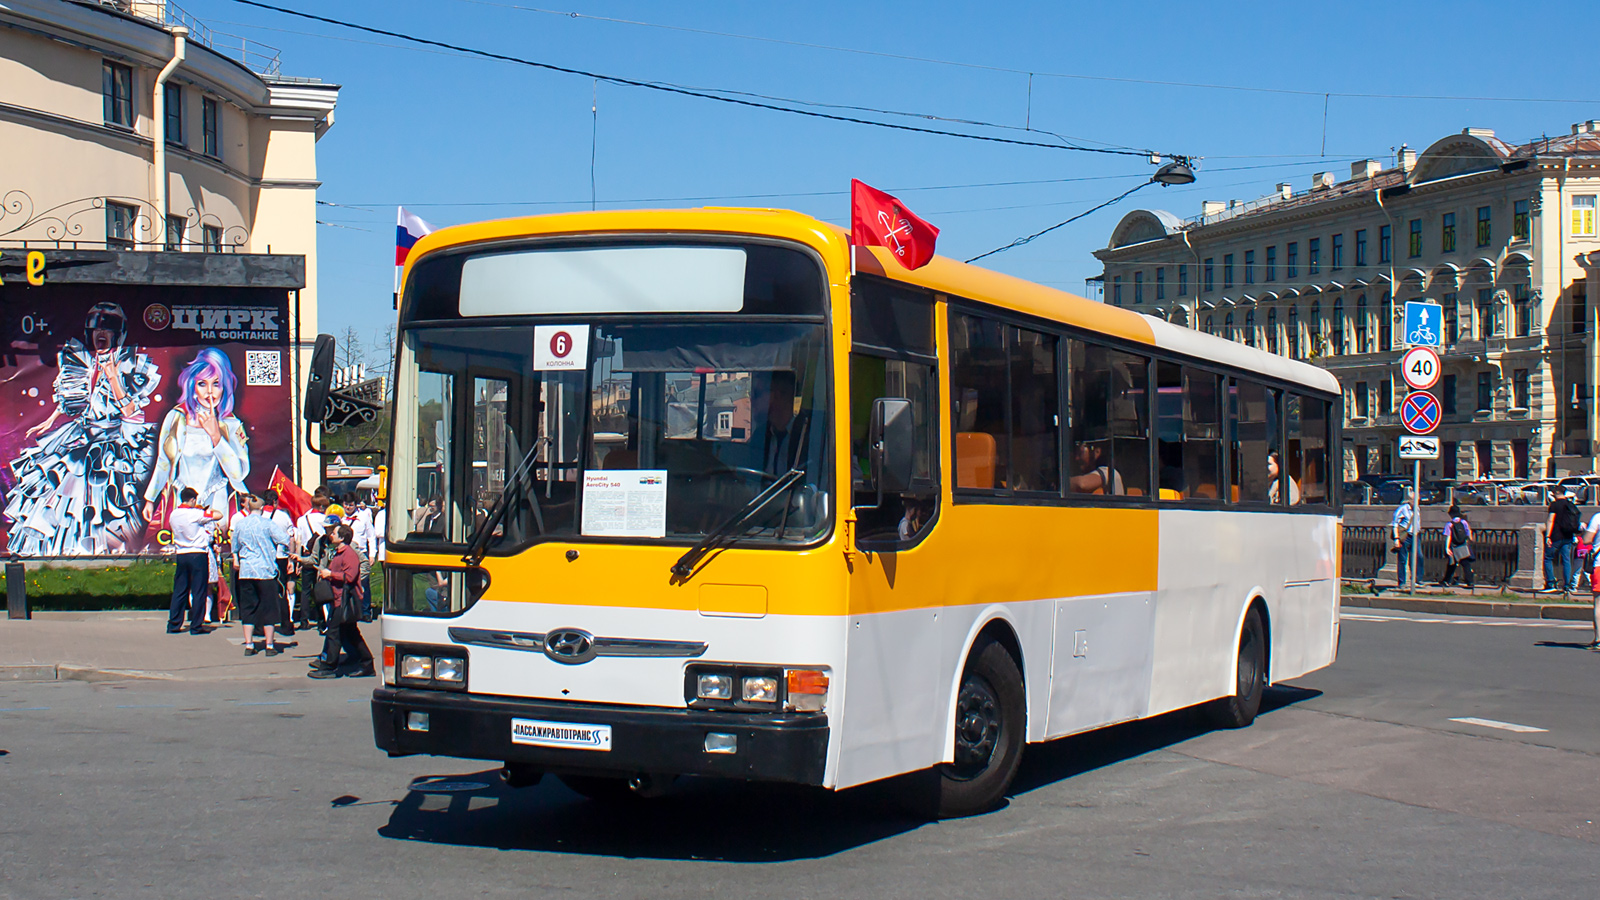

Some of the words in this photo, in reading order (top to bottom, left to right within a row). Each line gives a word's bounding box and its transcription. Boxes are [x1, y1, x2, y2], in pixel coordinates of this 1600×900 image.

[21, 315, 48, 334] 0+
[171, 309, 279, 332] ЦИРК
[201, 331, 216, 339] НА
[220, 331, 279, 340] ФОНТАНКЕ
[556, 336, 566, 354] 6
[1411, 360, 1432, 376] 40
[514, 724, 591, 741] ПАССАЖИРАВТОТРАНС
